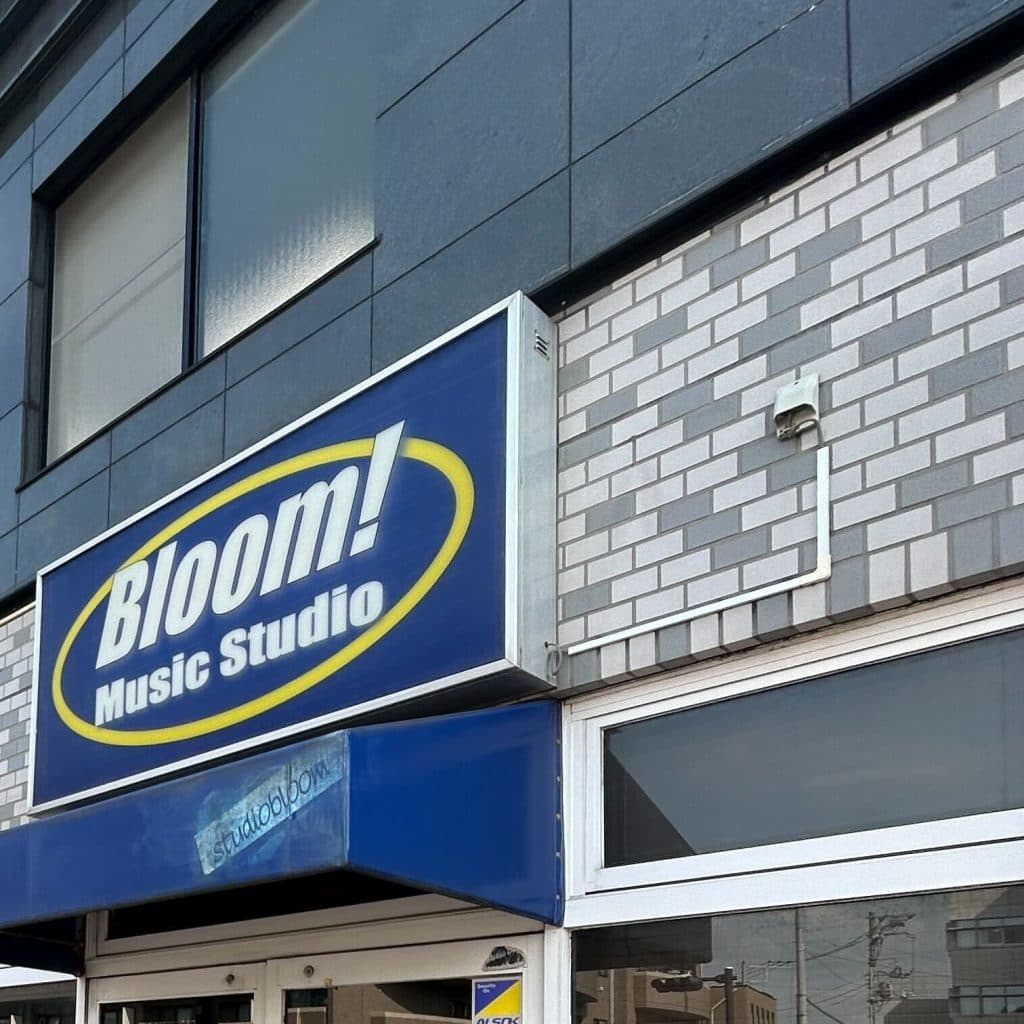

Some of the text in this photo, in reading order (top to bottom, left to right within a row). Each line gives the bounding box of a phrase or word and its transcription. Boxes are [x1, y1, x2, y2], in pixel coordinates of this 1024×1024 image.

[95, 419, 406, 670] Bloom!
[94, 580, 385, 727] Music Studio
